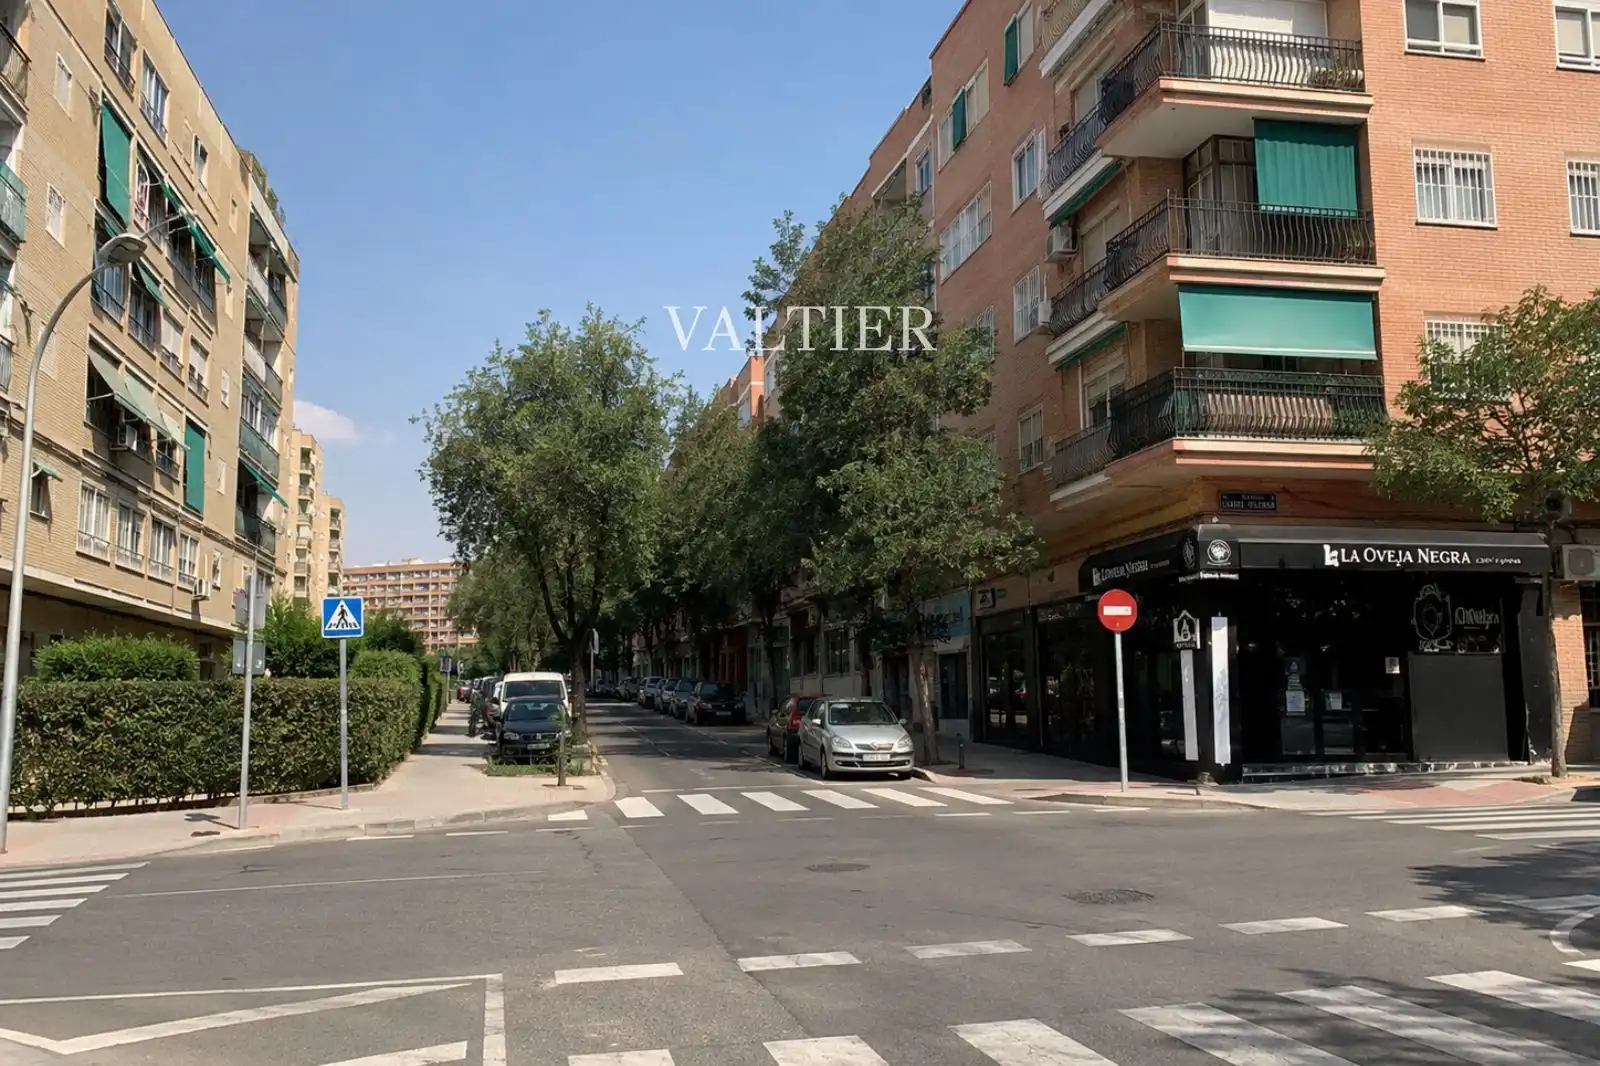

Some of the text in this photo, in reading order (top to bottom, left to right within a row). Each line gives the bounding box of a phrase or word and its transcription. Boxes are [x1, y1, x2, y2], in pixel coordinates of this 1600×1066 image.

[1340, 548, 1360, 563] LA
[1363, 547, 1414, 567] OVEJA
[1417, 548, 1471, 564] NEGRA
